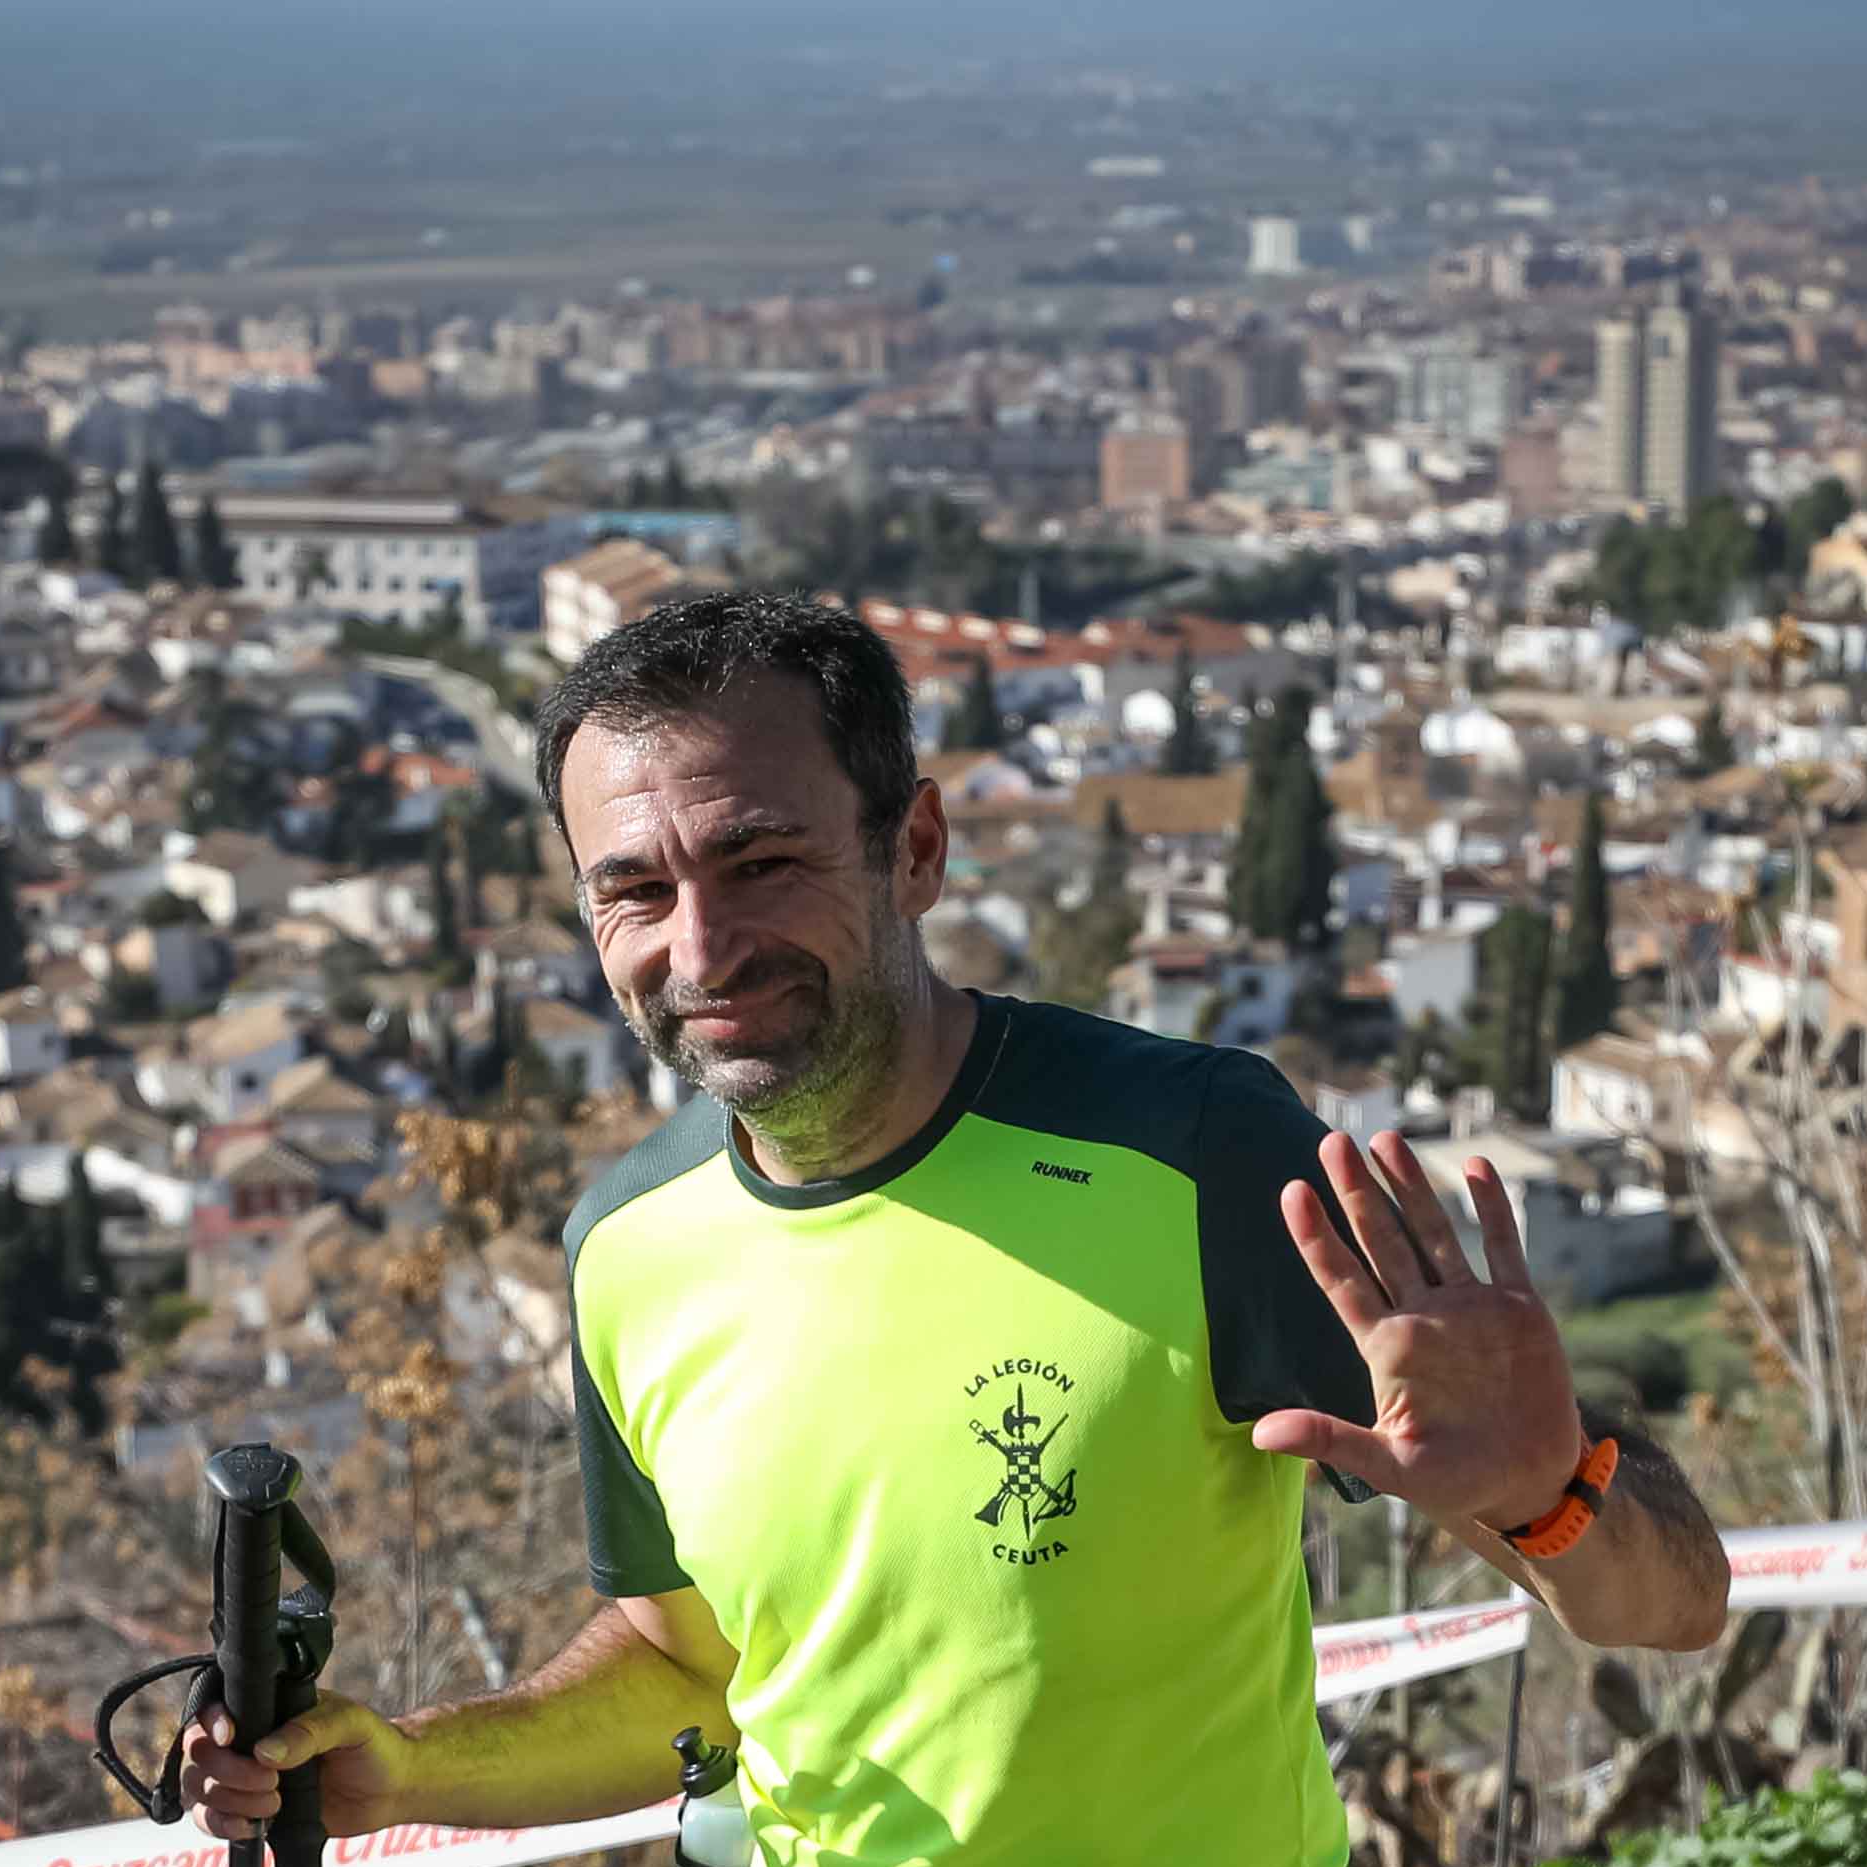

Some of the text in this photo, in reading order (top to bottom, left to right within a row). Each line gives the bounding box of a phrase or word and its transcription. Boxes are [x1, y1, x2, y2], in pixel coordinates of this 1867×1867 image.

[1031, 1160, 1093, 1185] RUNNEK
[964, 1357, 1075, 1397] LA LEGIÓN
[991, 1540, 1069, 1566] CEUTA
